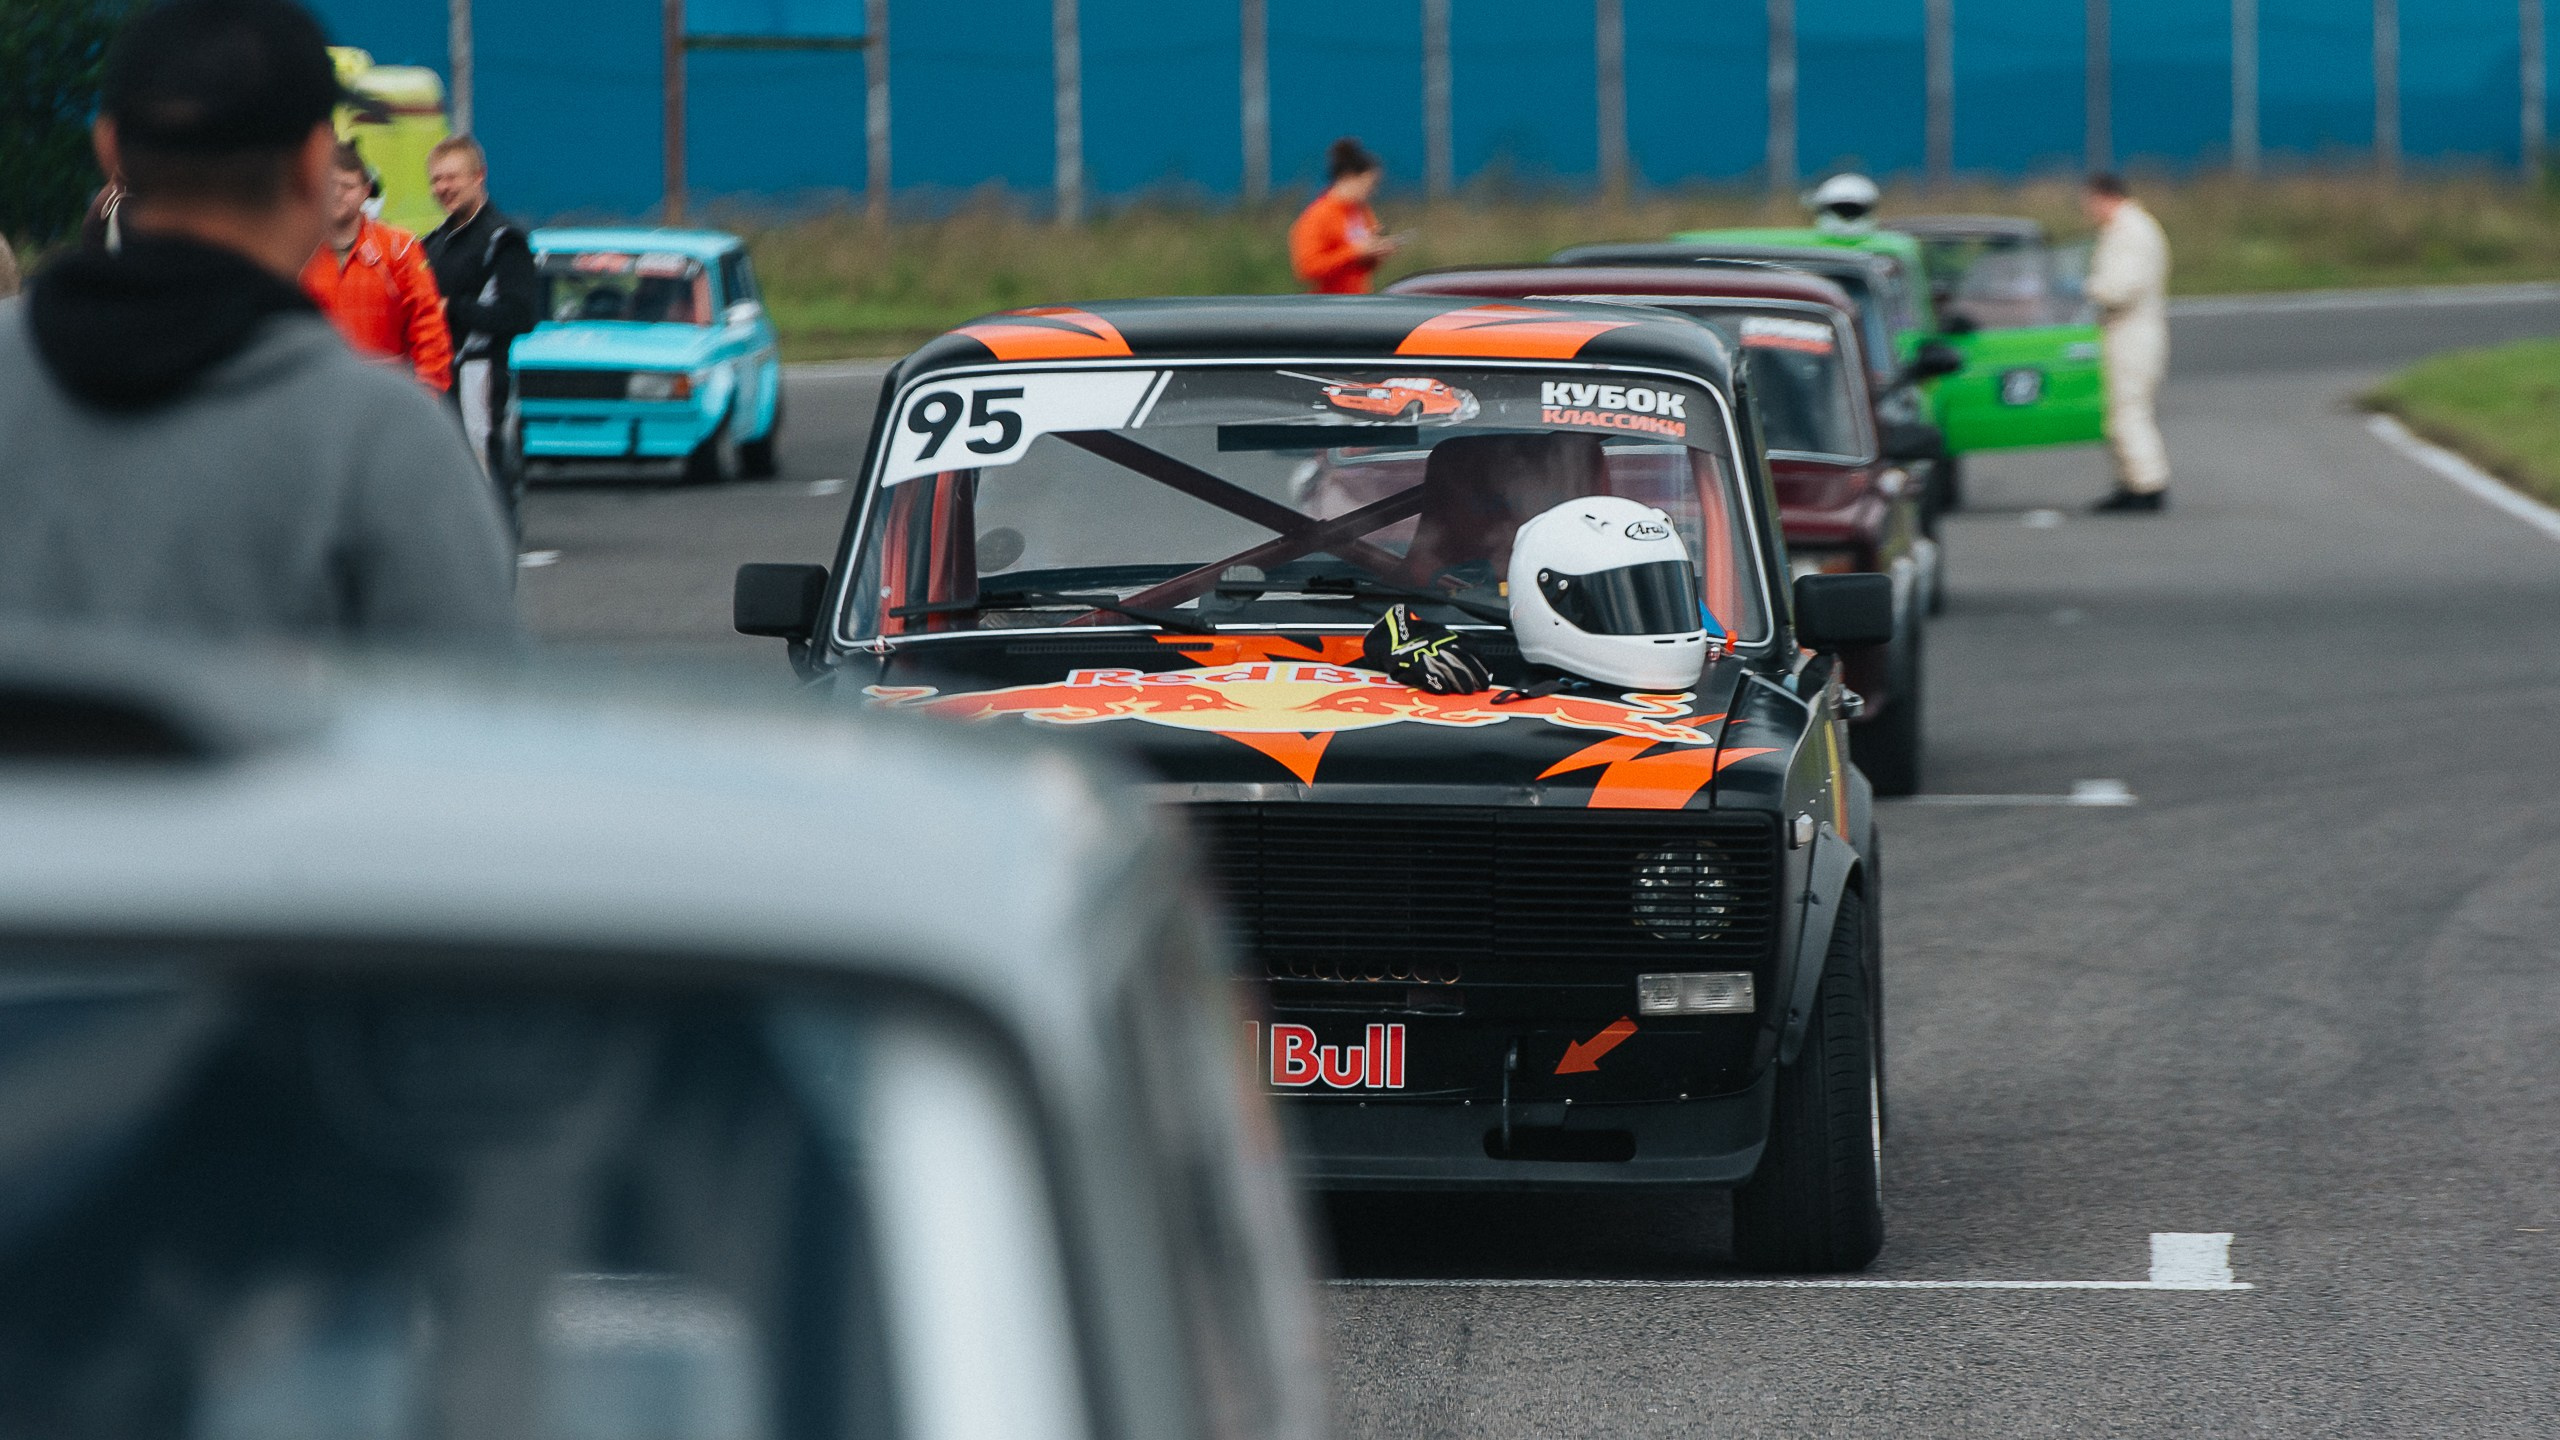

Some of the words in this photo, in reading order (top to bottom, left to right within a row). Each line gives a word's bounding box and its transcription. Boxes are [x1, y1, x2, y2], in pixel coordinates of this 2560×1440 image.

[1541, 381, 1686, 418] КУБОК
[907, 386, 1024, 462] 95
[1542, 408, 1686, 438] КЛАССИКИ
[1066, 664, 1271, 687] Red
[1271, 1024, 1405, 1088] Bull
